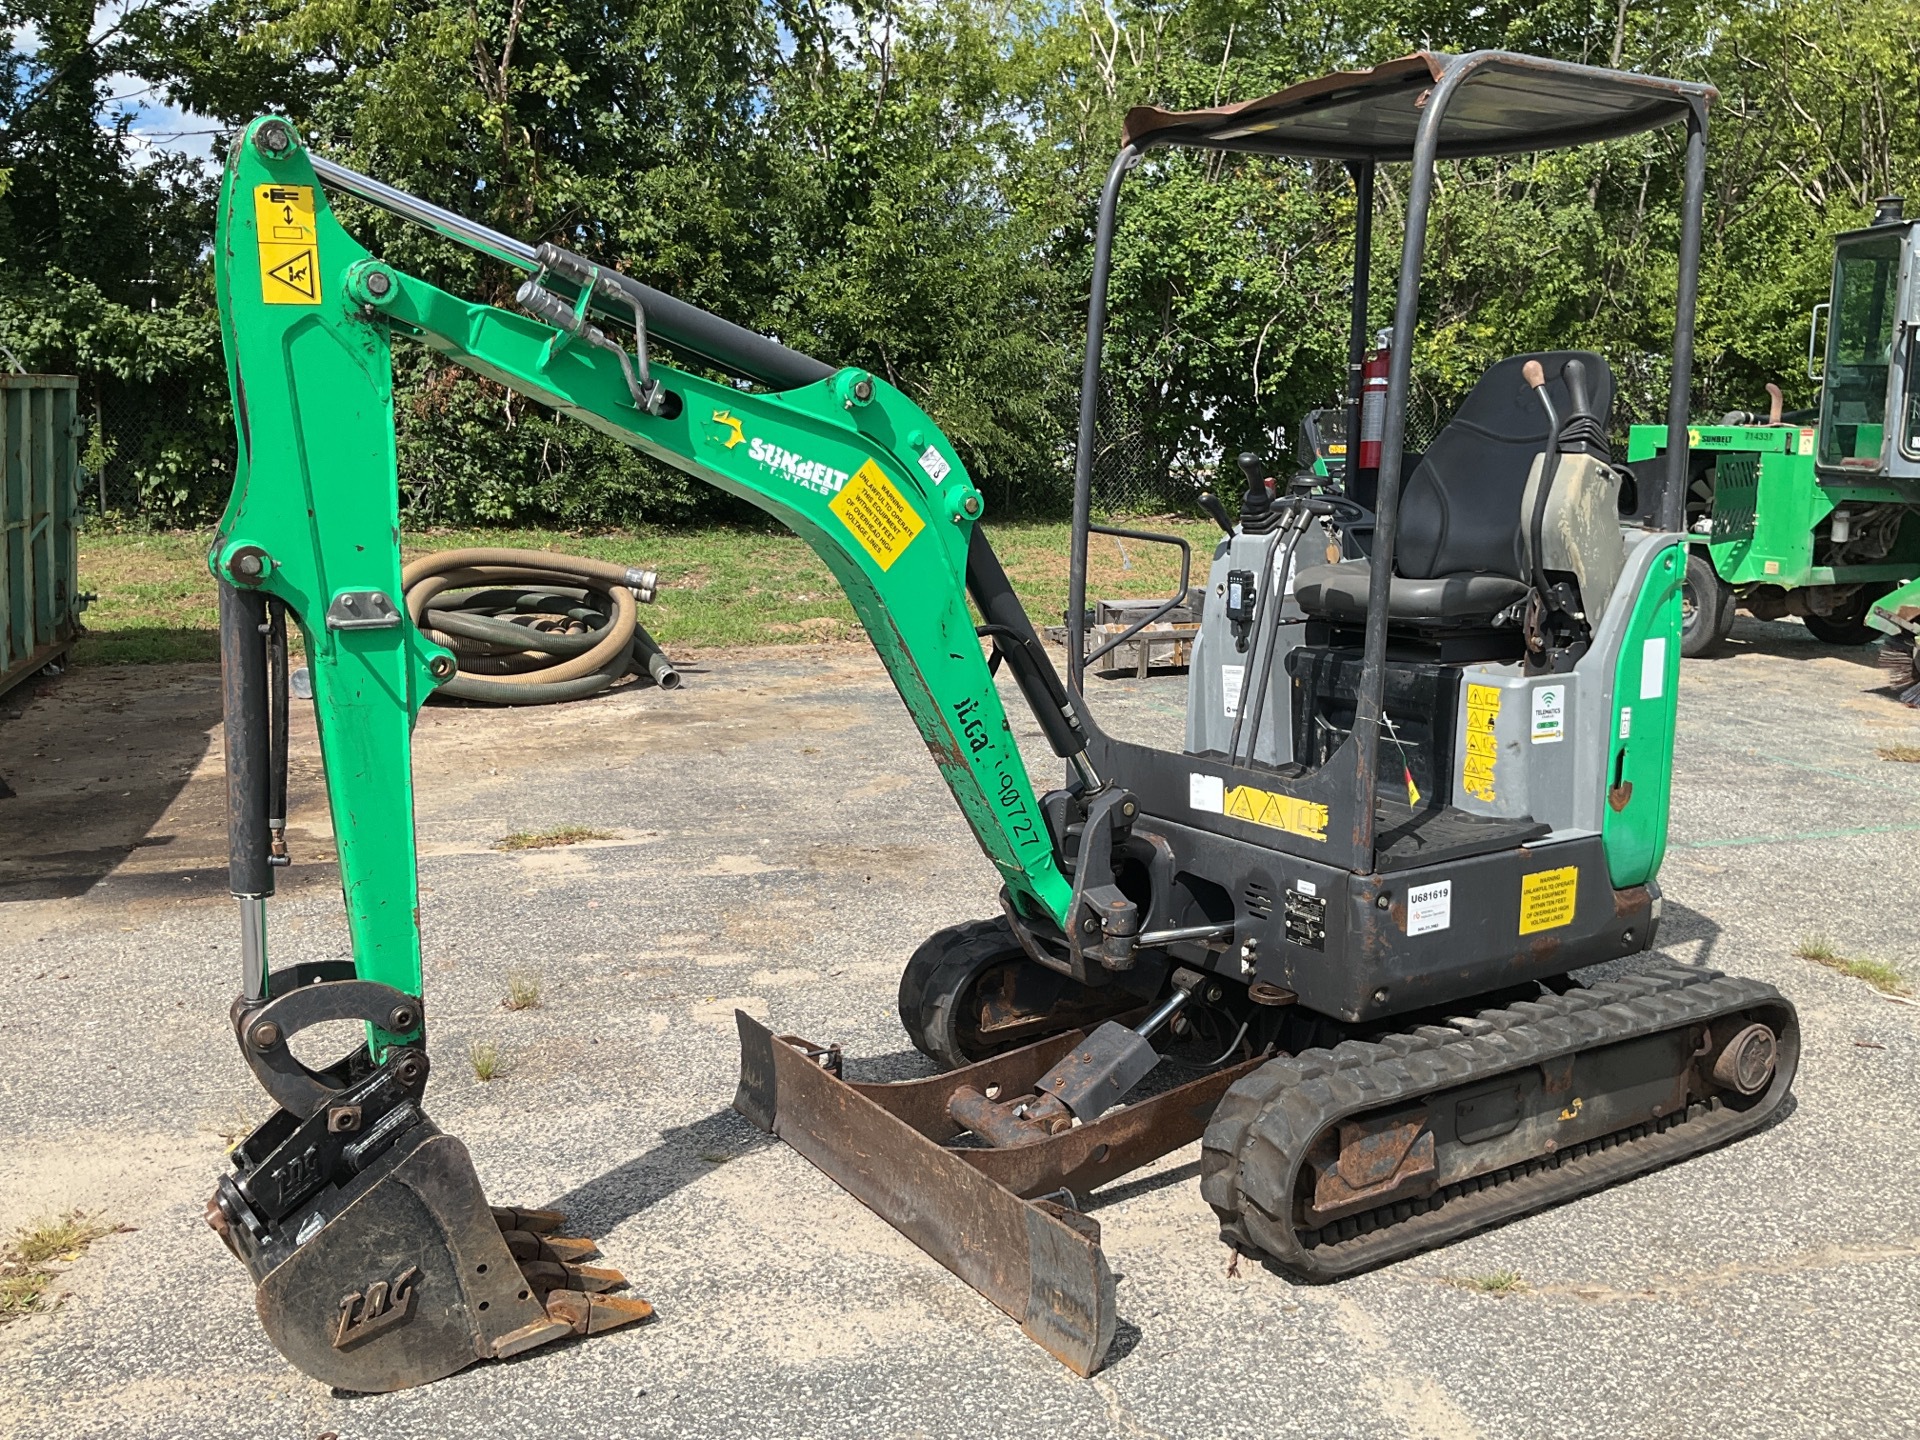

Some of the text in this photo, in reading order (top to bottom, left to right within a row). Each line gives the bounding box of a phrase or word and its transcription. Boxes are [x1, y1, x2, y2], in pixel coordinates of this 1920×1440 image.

[1745, 432, 1773, 441] 714337
[859, 471, 914, 538] UNLAWFUL TO OPERATE
[881, 484, 904, 513] WARNING
[855, 494, 895, 542] WITHIN TEN FEET
[861, 488, 901, 535] THIS EQUIPMENT
[845, 510, 882, 554] VOLTAGE LINES
[846, 498, 893, 553] OF OVERHEAD HIGH
[1535, 708, 1561, 716] TELEMATICS
[1540, 874, 1561, 883] WARNING
[1523, 886, 1547, 895] UNLAWFUL
[1554, 879, 1575, 889] OPERATE
[1541, 889, 1567, 899] EQUIPMENT
[1411, 888, 1448, 904] U681619
[1530, 902, 1545, 910] WITHIN
[1533, 907, 1557, 917] OVERHEAD
[1530, 913, 1564, 926] VOLTAGE LINES
